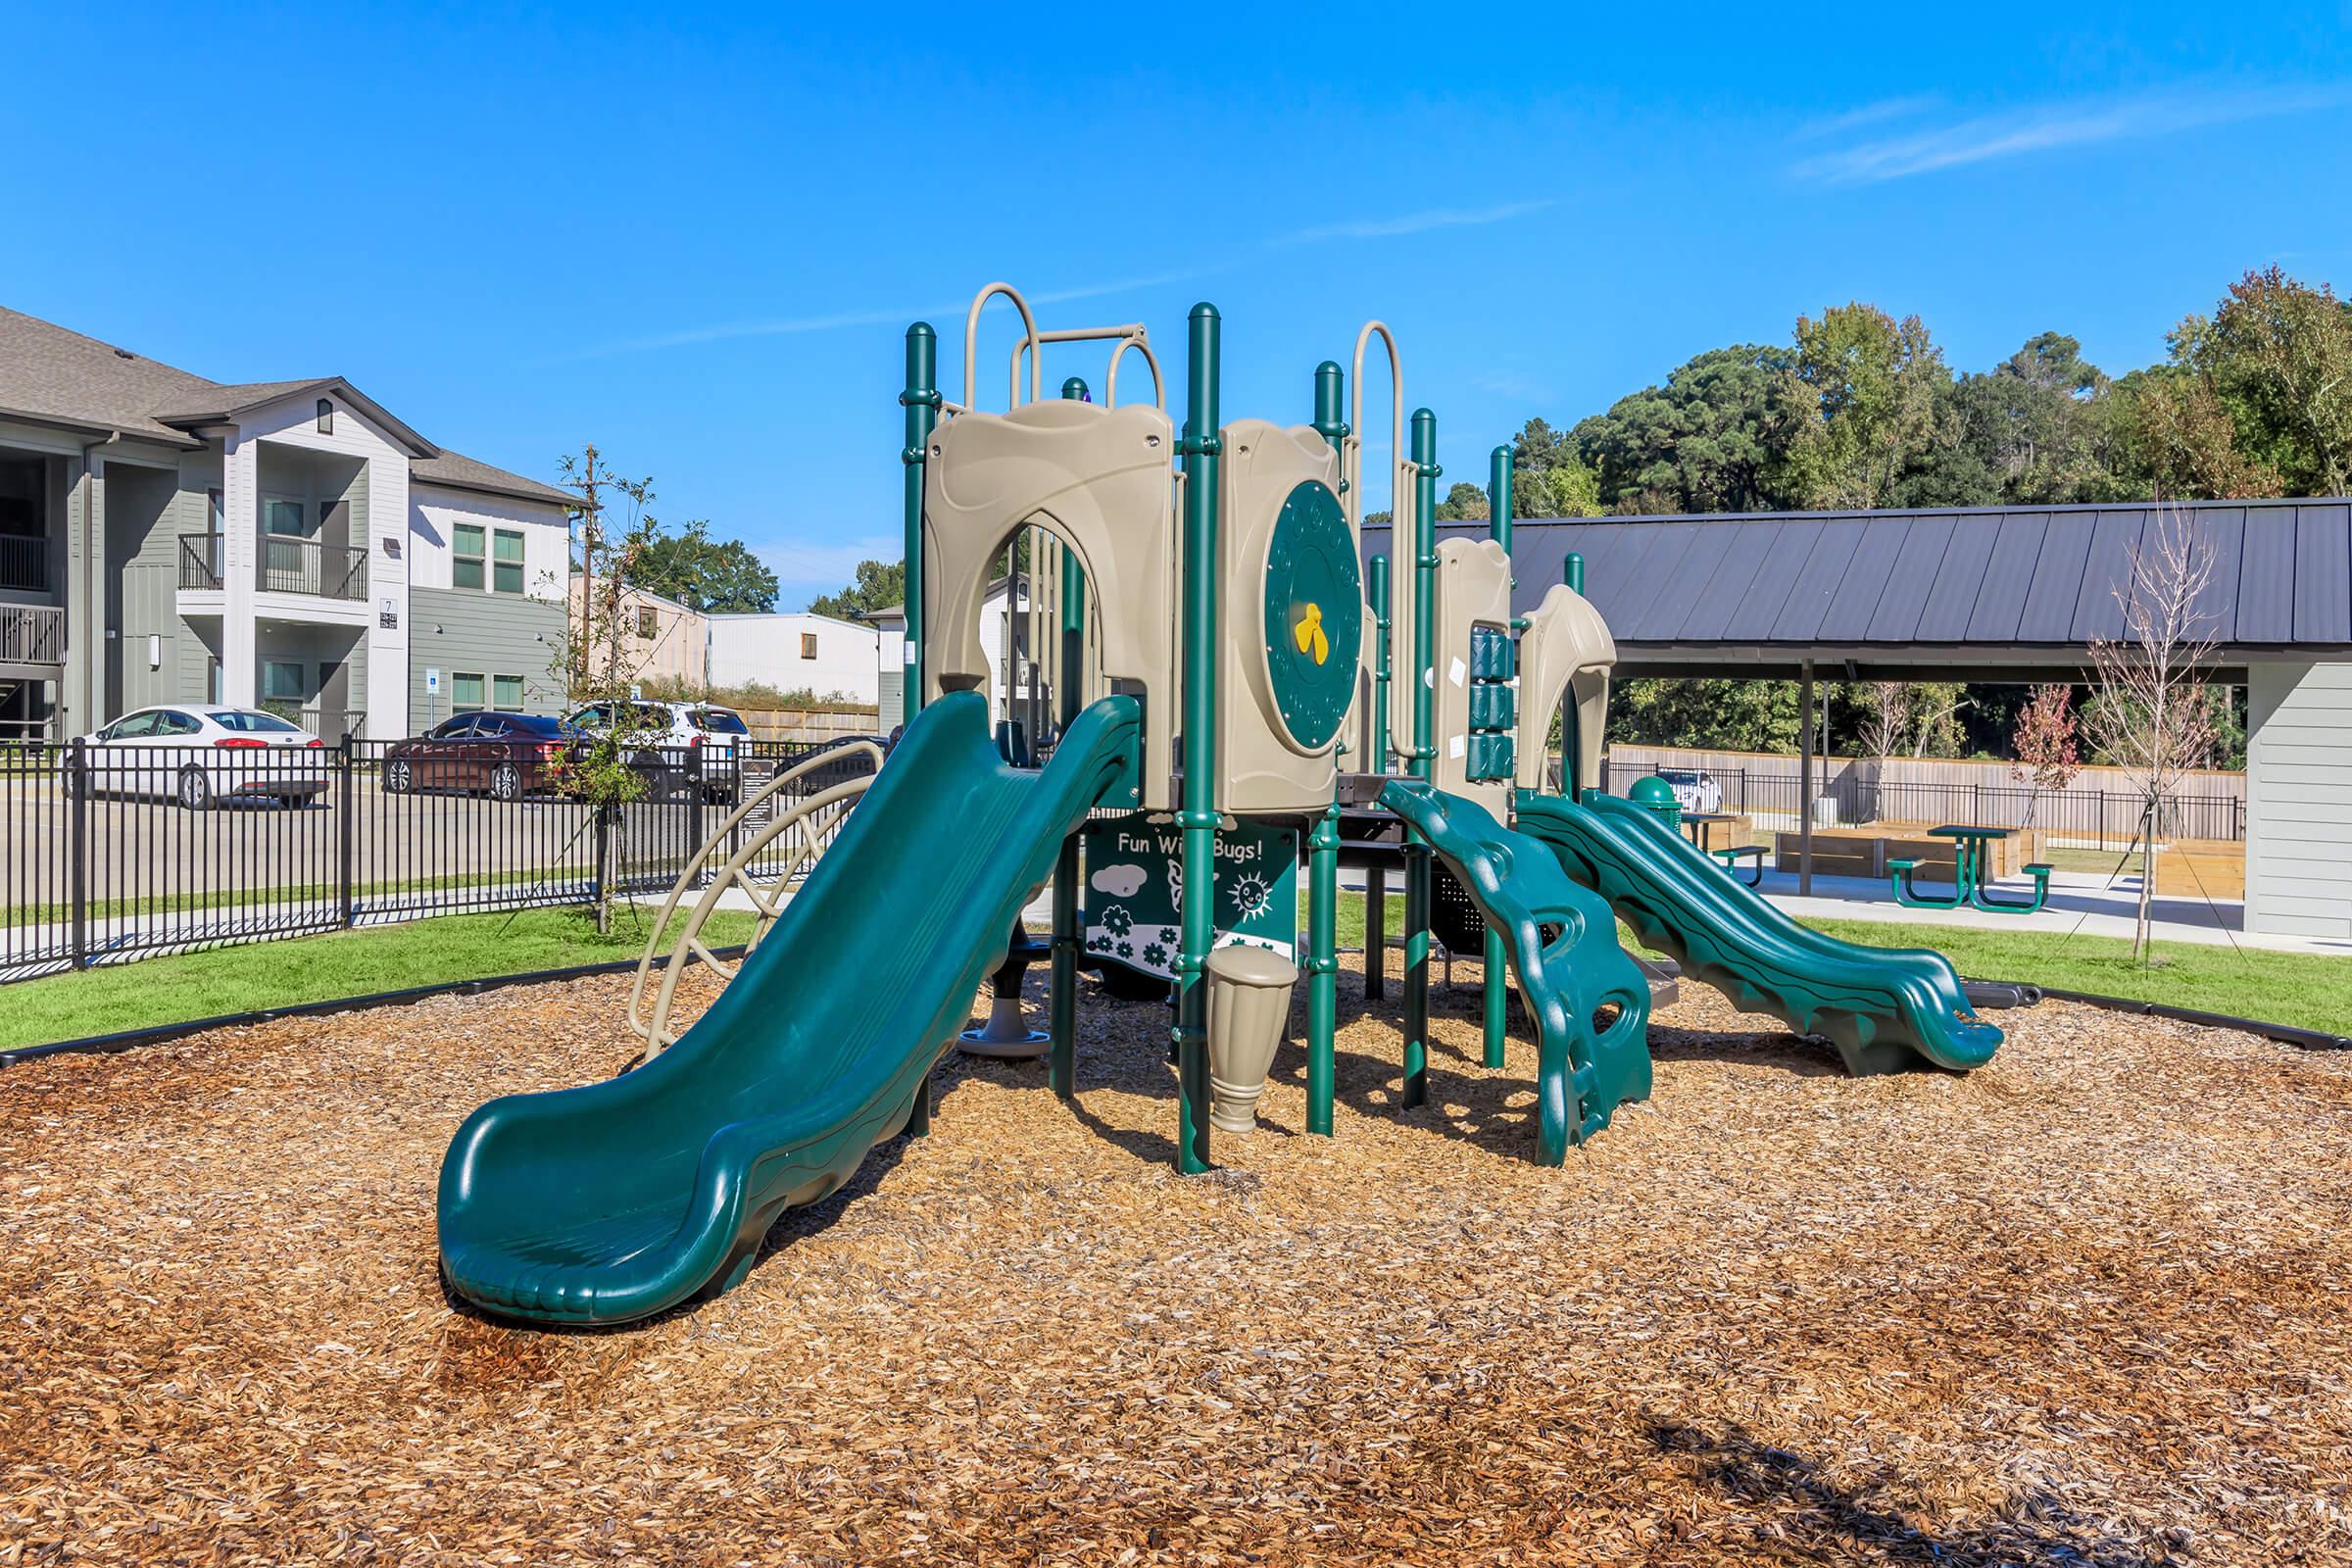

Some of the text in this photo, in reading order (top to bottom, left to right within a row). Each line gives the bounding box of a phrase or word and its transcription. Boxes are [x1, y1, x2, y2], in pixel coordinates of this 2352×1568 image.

[385, 600, 392, 612] 7
[1118, 832, 1262, 864] Fun Wi Bugs!
